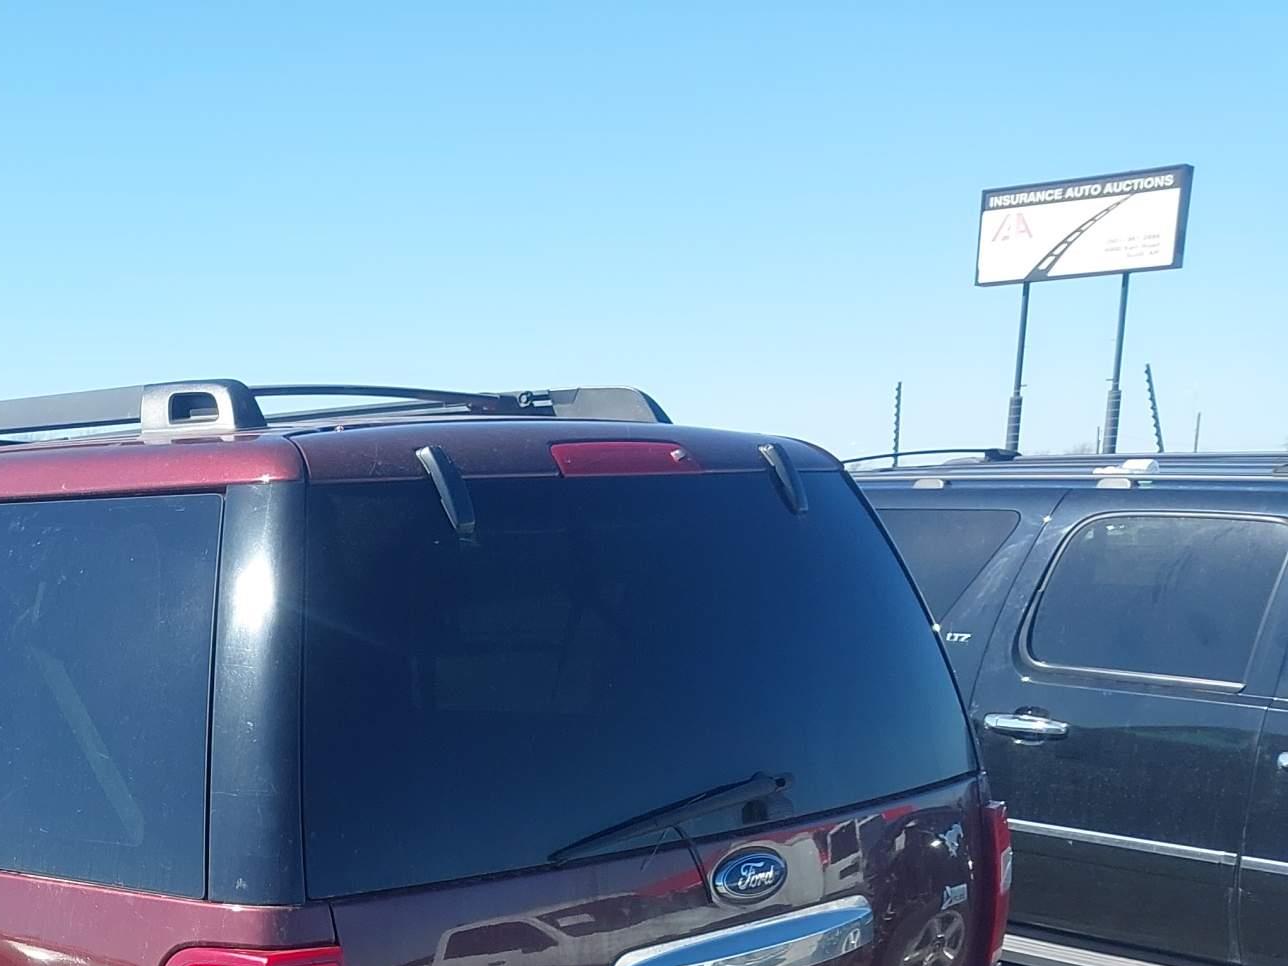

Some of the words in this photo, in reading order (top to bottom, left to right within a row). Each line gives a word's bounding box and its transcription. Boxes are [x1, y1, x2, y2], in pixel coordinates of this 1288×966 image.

[988, 188, 1063, 208] INSURANCE
[1064, 183, 1102, 200] AUTO
[1103, 174, 1175, 193] AUCTIONS
[946, 632, 972, 643] LTZ
[737, 862, 775, 890] Ford
